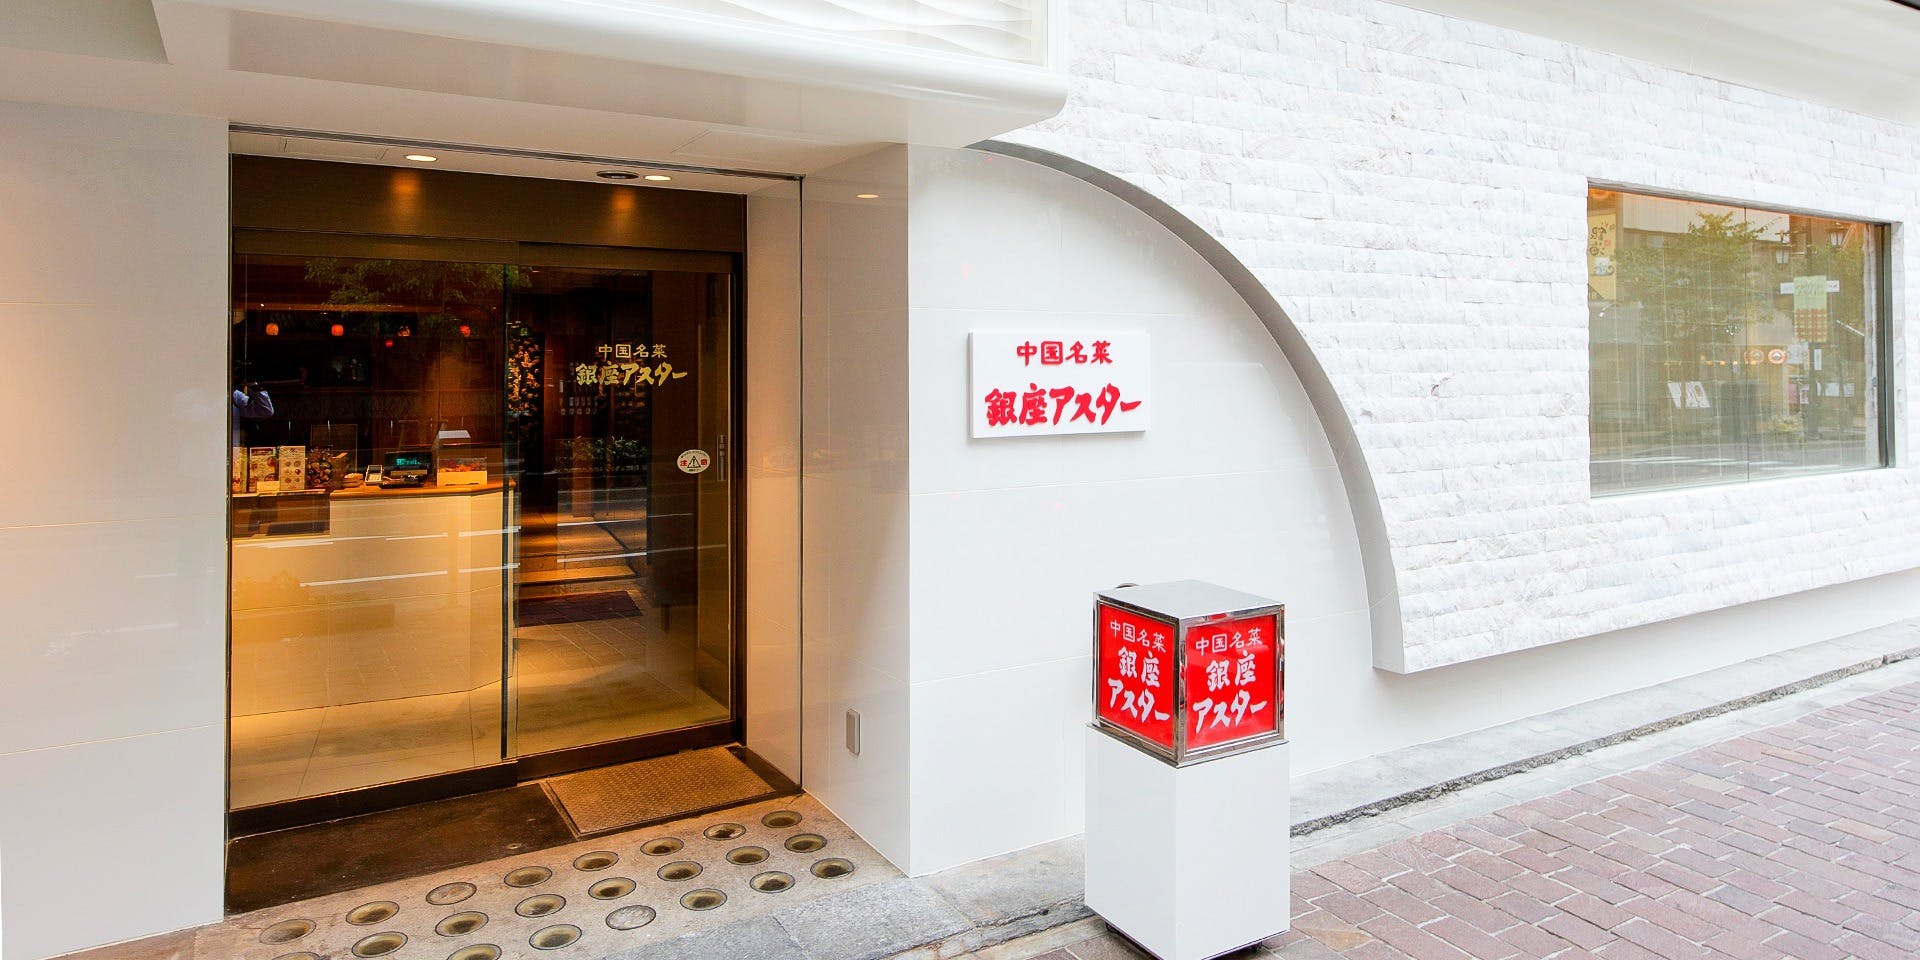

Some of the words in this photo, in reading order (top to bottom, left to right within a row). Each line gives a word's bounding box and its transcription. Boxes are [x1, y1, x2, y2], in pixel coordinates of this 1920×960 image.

[598, 343, 668, 360] 中国名菜
[1016, 341, 1113, 366] 中国名菜
[575, 361, 688, 386] 銀座アスター
[984, 382, 1142, 427] 銀座アスター
[1109, 618, 1167, 653] 中国名菜
[1195, 627, 1263, 657] 中国名菜
[1117, 646, 1161, 688] 銀座
[1205, 650, 1257, 692] 銀座
[1107, 677, 1171, 723] アスター
[1192, 689, 1268, 734] アスター
